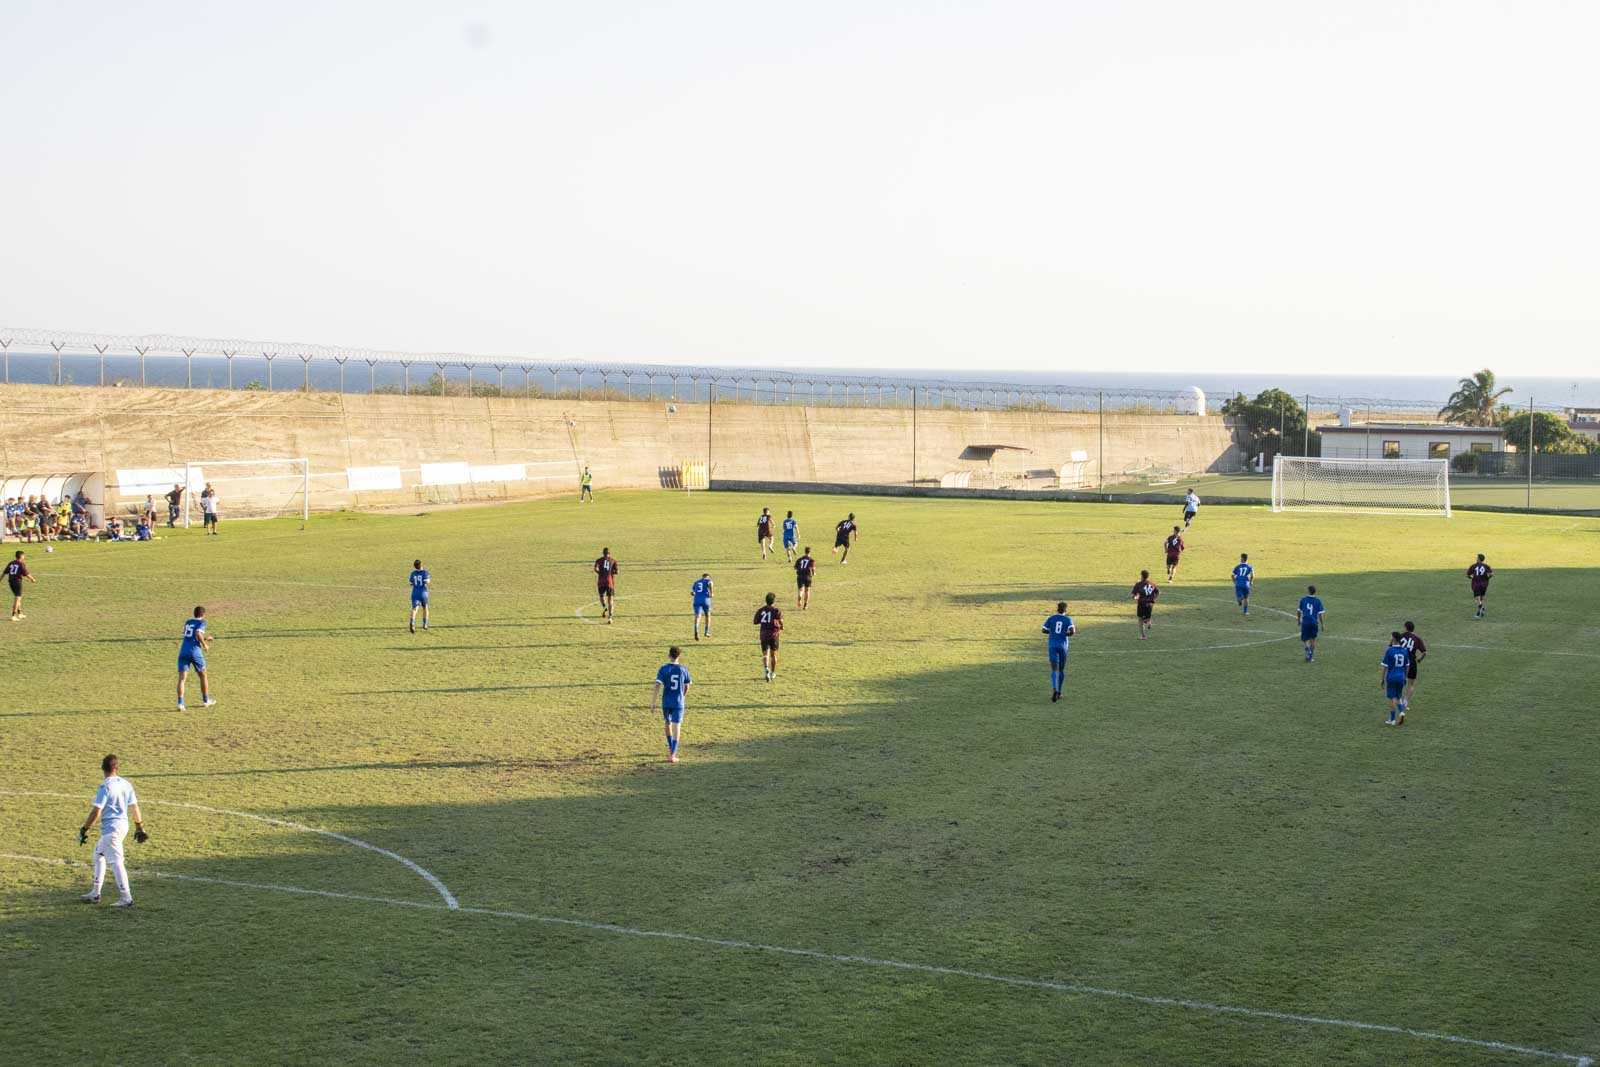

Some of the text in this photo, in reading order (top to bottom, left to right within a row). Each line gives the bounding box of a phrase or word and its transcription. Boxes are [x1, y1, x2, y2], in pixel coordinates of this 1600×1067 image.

[9, 564, 18, 574] 27
[603, 560, 610, 570] 4
[800, 560, 808, 568] 17
[1239, 567, 1247, 576] 17
[1475, 566, 1485, 575] 19
[414, 576, 422, 585] 19
[697, 583, 702, 592] 3
[1144, 584, 1153, 594] 16
[1307, 603, 1313, 615] 4
[761, 611, 771, 622] 21
[184, 624, 193, 637] 15
[1055, 621, 1062, 634] 8
[1400, 638, 1414, 651] 24
[1394, 654, 1404, 667] 13
[670, 675, 678, 689] 5
